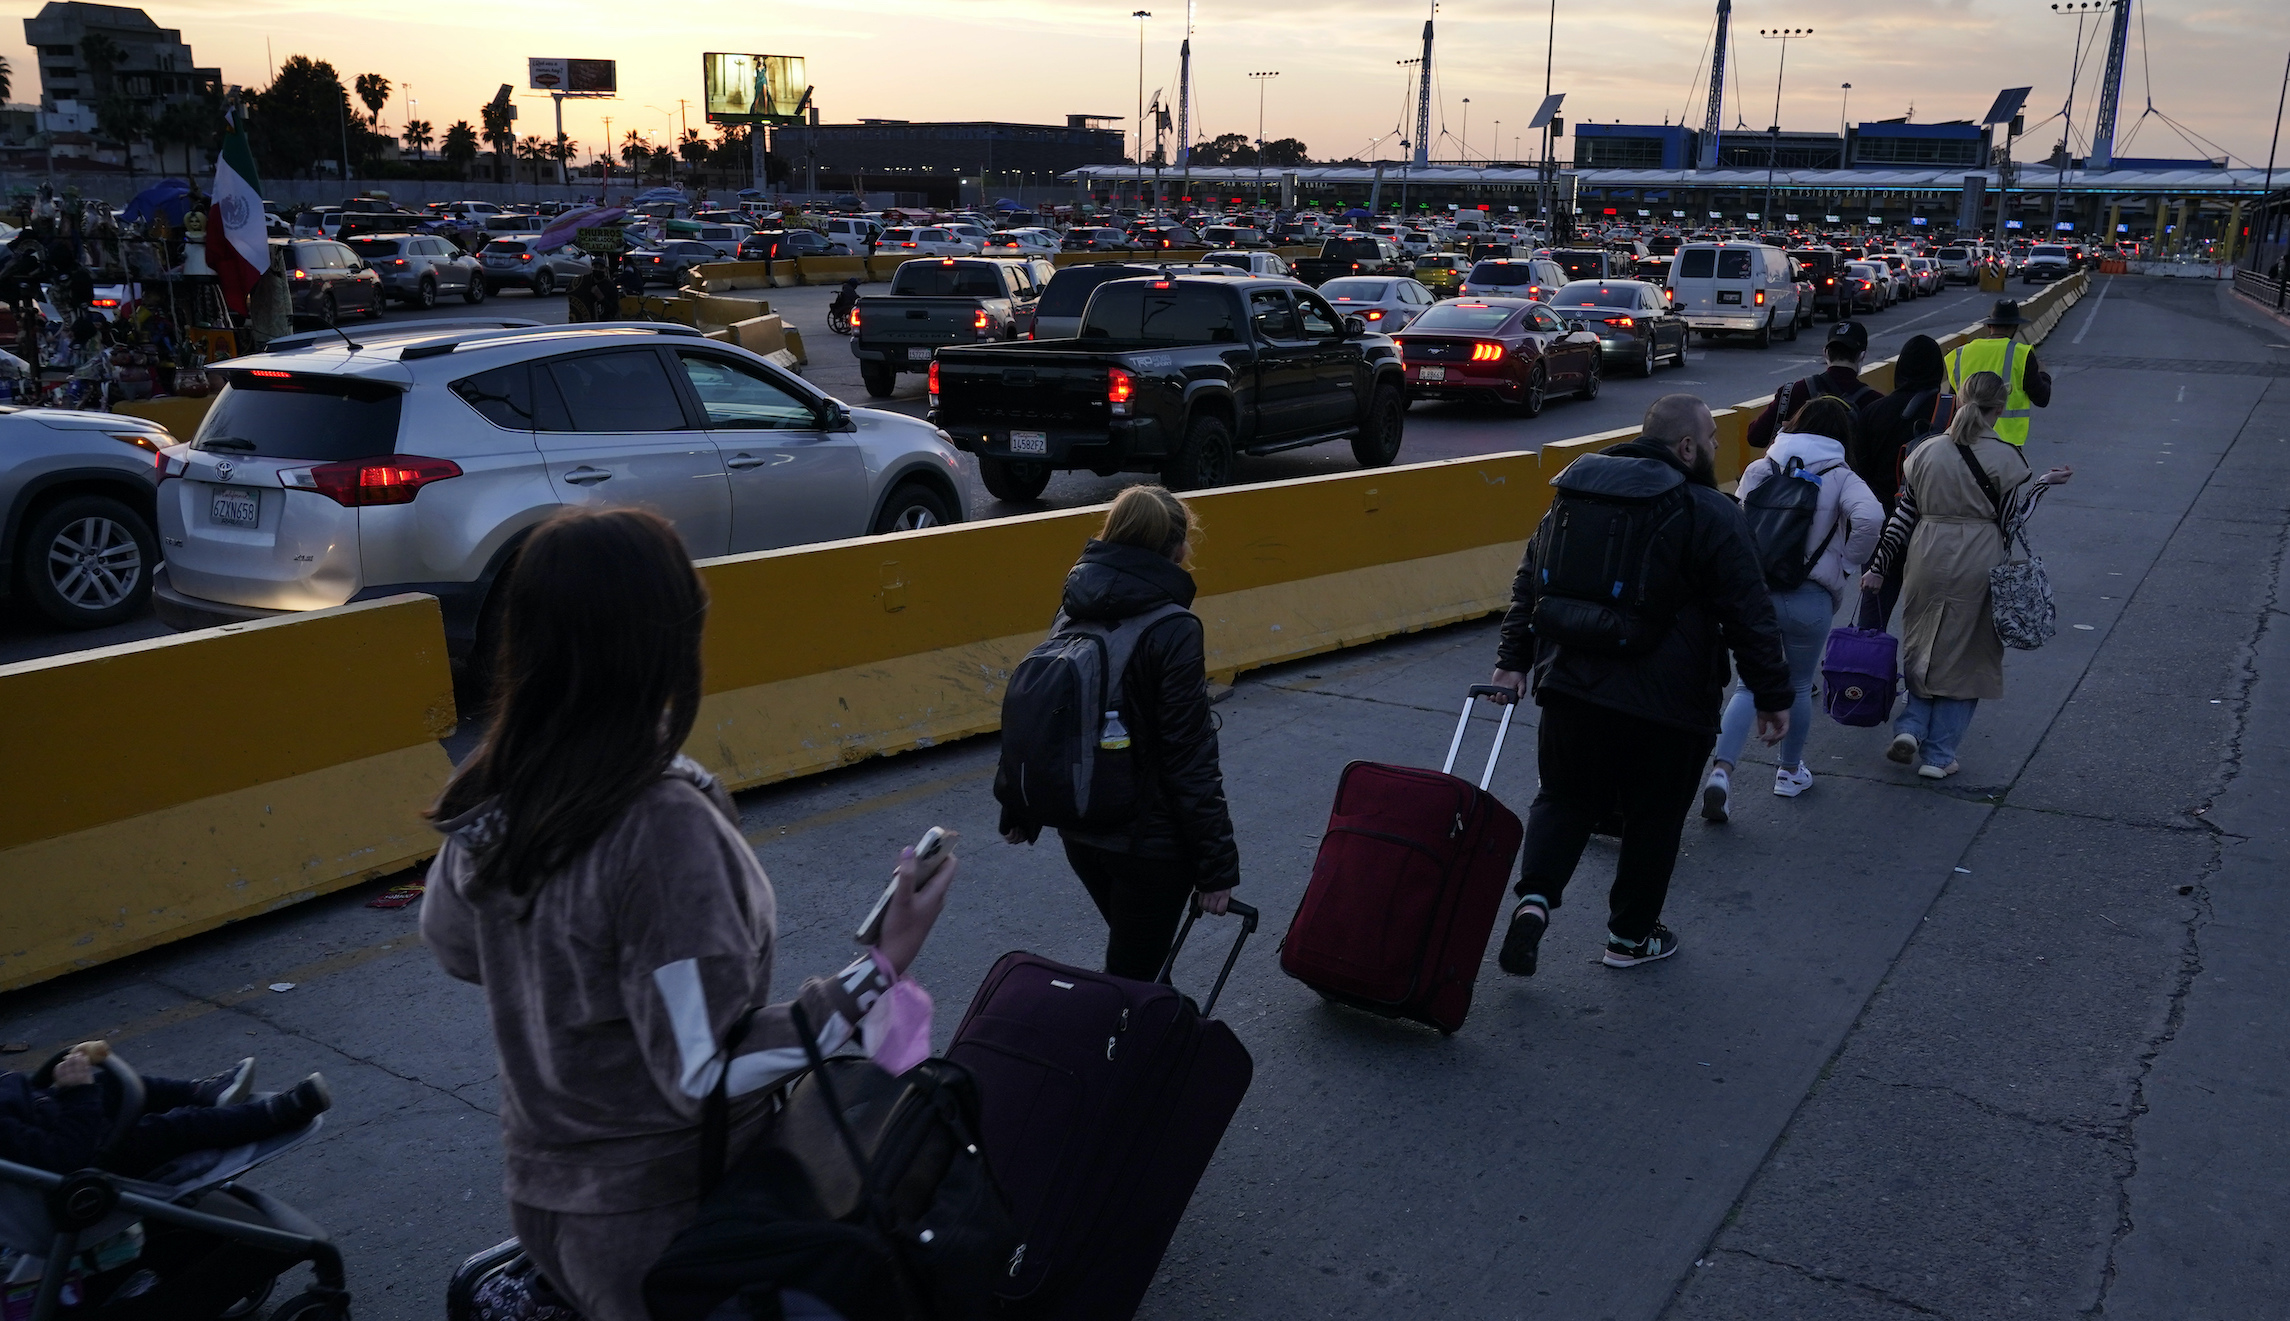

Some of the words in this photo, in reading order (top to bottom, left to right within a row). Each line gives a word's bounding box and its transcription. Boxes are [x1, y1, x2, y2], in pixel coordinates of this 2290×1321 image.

[1771, 188, 1792, 197] SAN
[1798, 189, 1840, 198] YSIDRO
[1845, 190, 1875, 198] PORT
[1882, 190, 1896, 199] OF
[1904, 190, 1943, 199] ENTRY
[579, 229, 622, 237] CHURROS
[1129, 356, 1153, 367] TRD
[977, 407, 1074, 420] TACOMA
[213, 500, 254, 521] 6ZXN658
